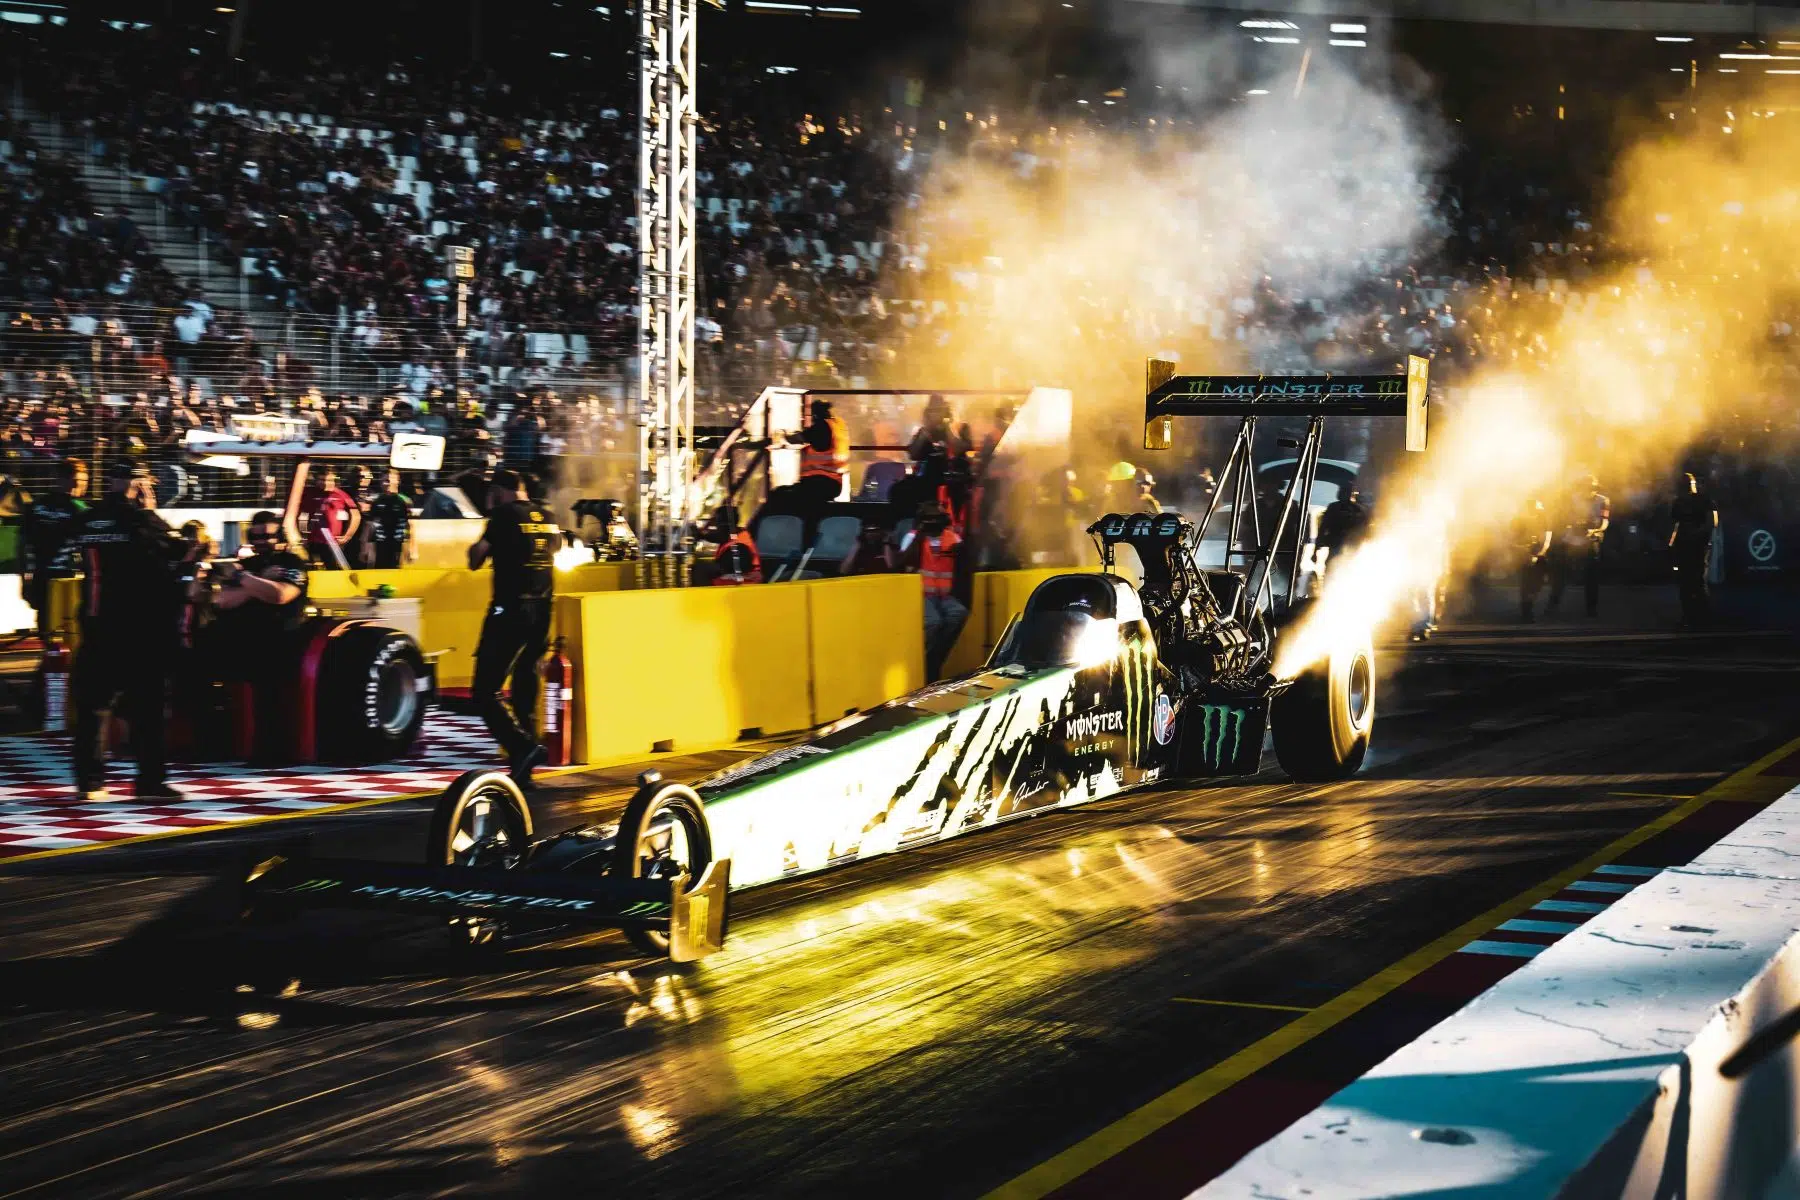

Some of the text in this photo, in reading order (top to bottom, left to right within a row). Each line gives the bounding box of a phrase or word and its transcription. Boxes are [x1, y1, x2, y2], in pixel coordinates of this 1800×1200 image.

[1222, 382, 1366, 398] MONSTER
[1066, 711, 1123, 741] MONSTER
[1075, 740, 1114, 757] ENERGY
